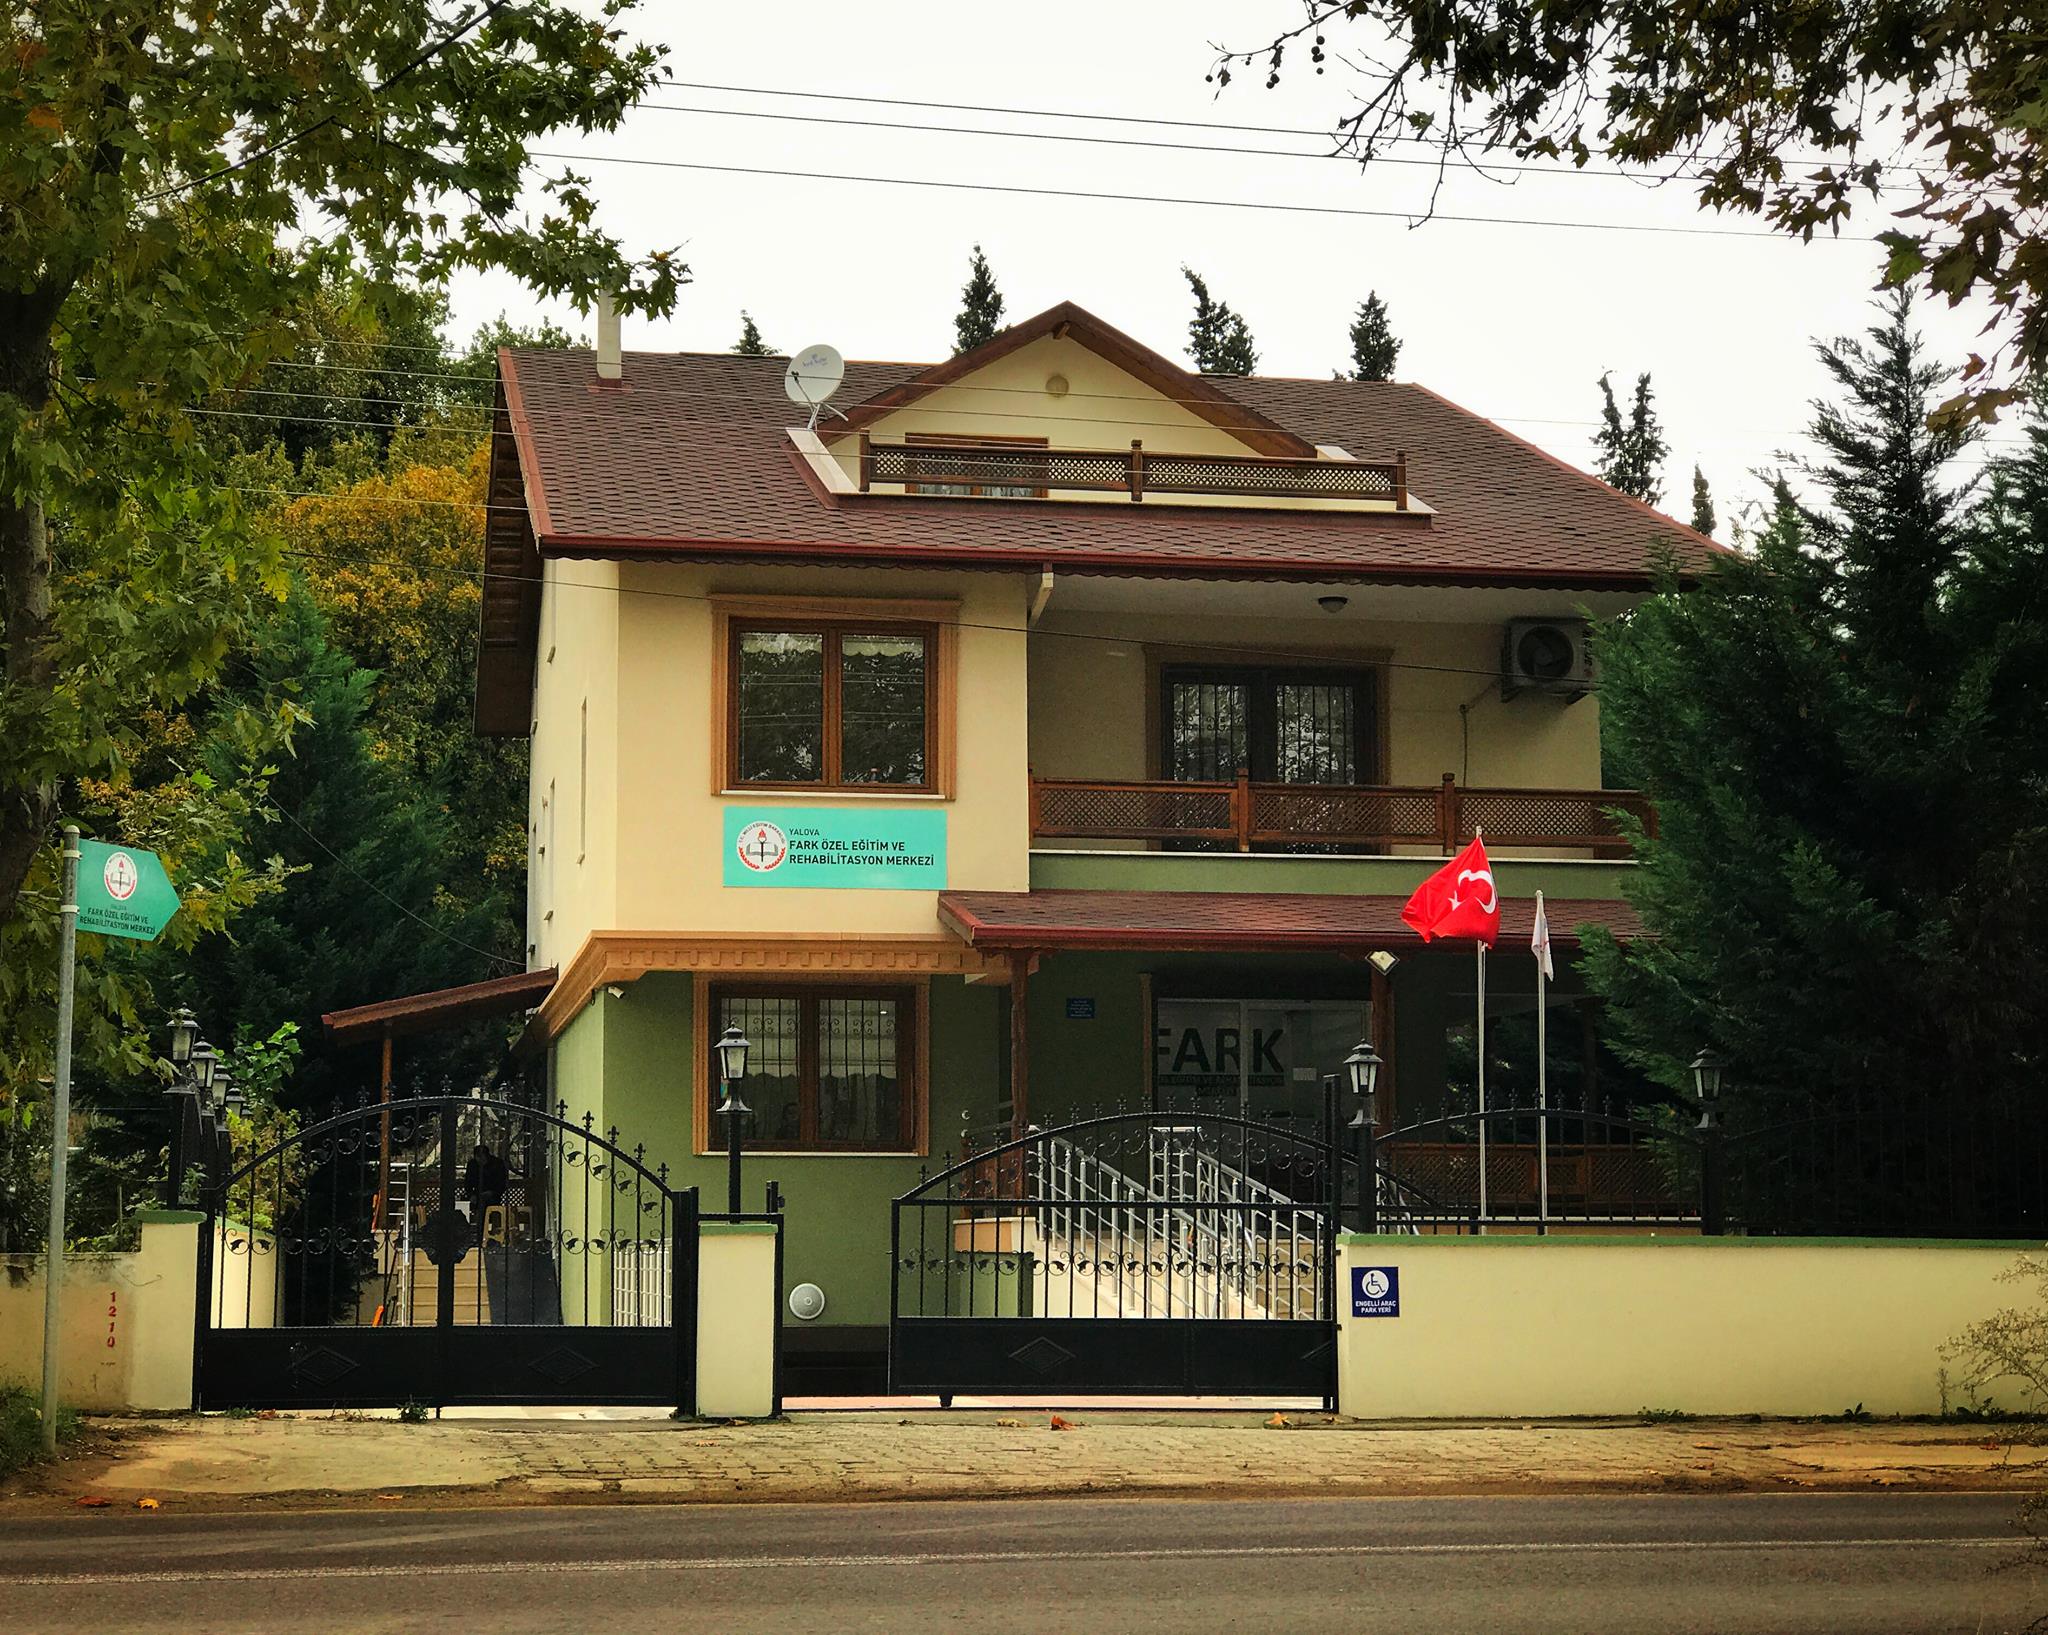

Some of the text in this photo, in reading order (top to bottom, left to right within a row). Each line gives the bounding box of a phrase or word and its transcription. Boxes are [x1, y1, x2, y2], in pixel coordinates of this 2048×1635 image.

[789, 828, 820, 836] YALOVA
[789, 838, 905, 851] FARK ÖZEL EĞİTİM VE
[789, 852, 934, 866] REHABİLİTASYON MERKEZİ
[87, 907, 103, 916] FARK
[140, 916, 148, 924] VE
